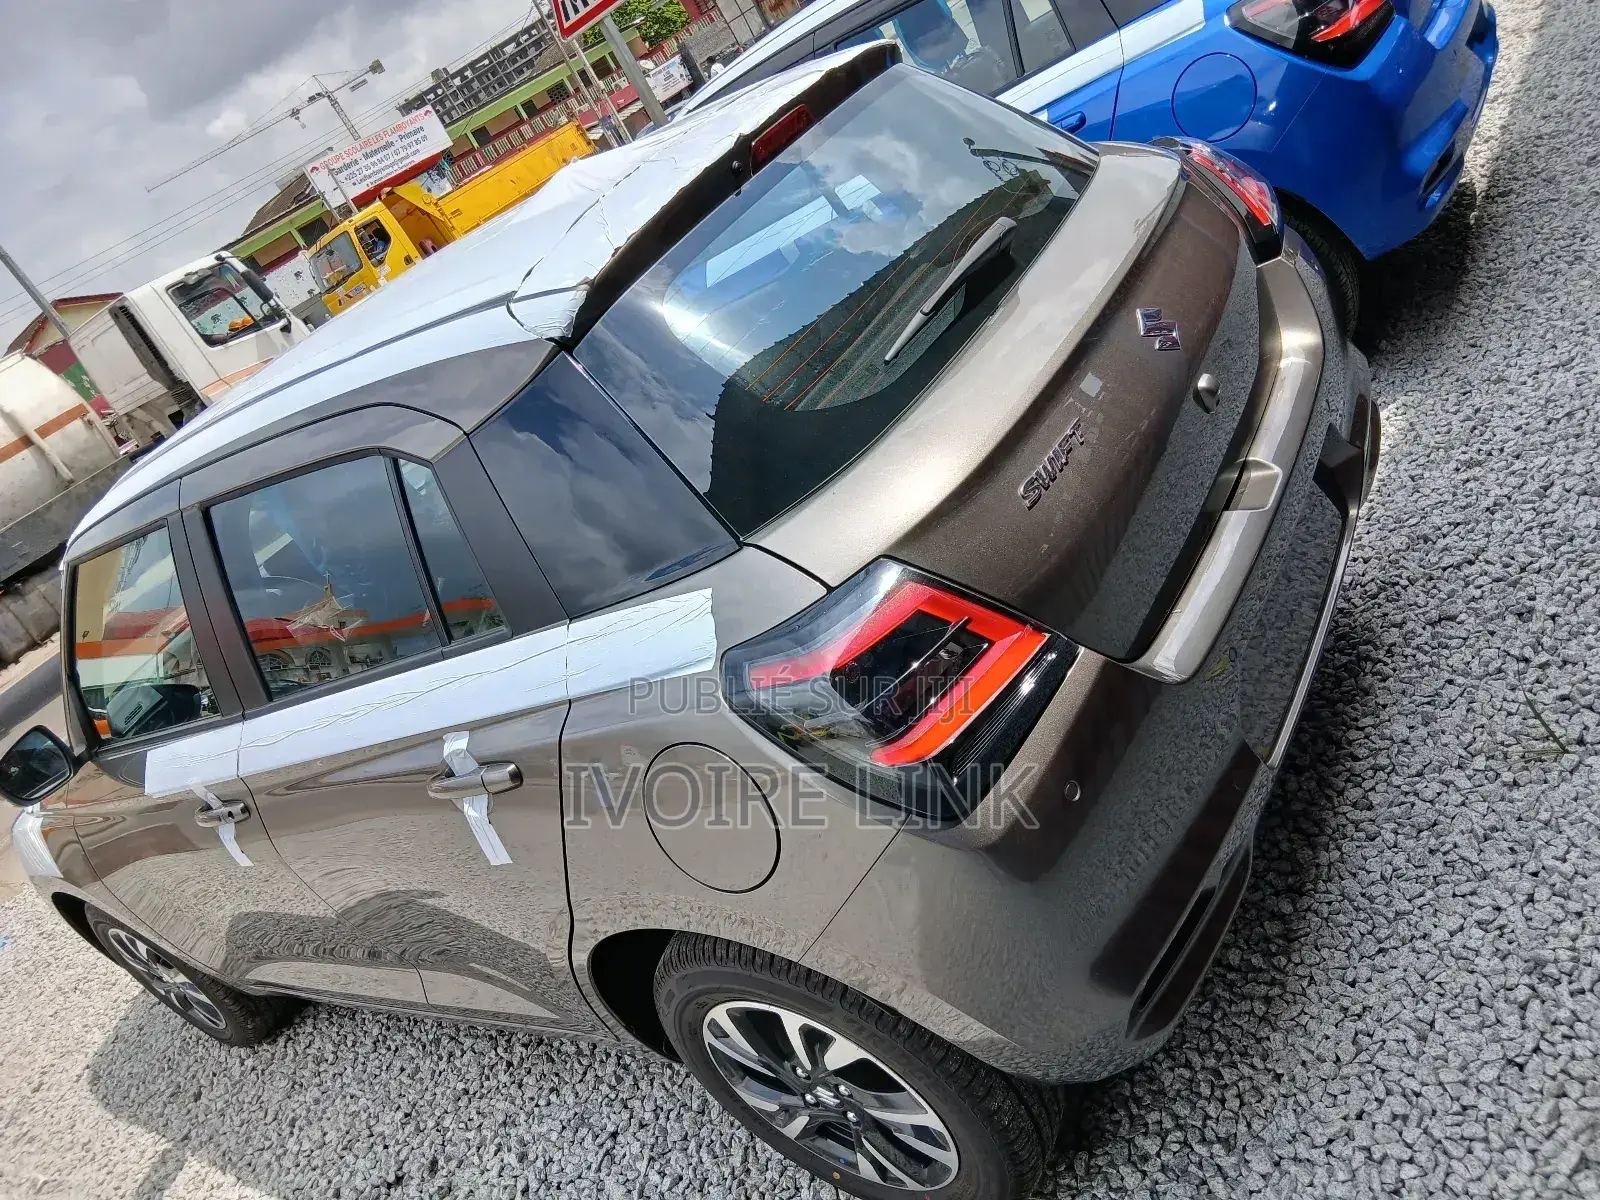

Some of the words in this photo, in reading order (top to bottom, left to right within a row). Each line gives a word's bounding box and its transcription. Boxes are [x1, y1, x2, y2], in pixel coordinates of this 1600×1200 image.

[330, 157, 360, 176] Garderie
[361, 139, 395, 161] Maternelle
[397, 124, 425, 143] Primaire
[343, 138, 374, 158] SCOLAIRE
[371, 133, 384, 144] LES
[382, 112, 425, 138] FLAMBOYANTS
[342, 170, 357, 182] +225
[355, 167, 364, 175] 27
[1018, 417, 1085, 511] SWIFT
